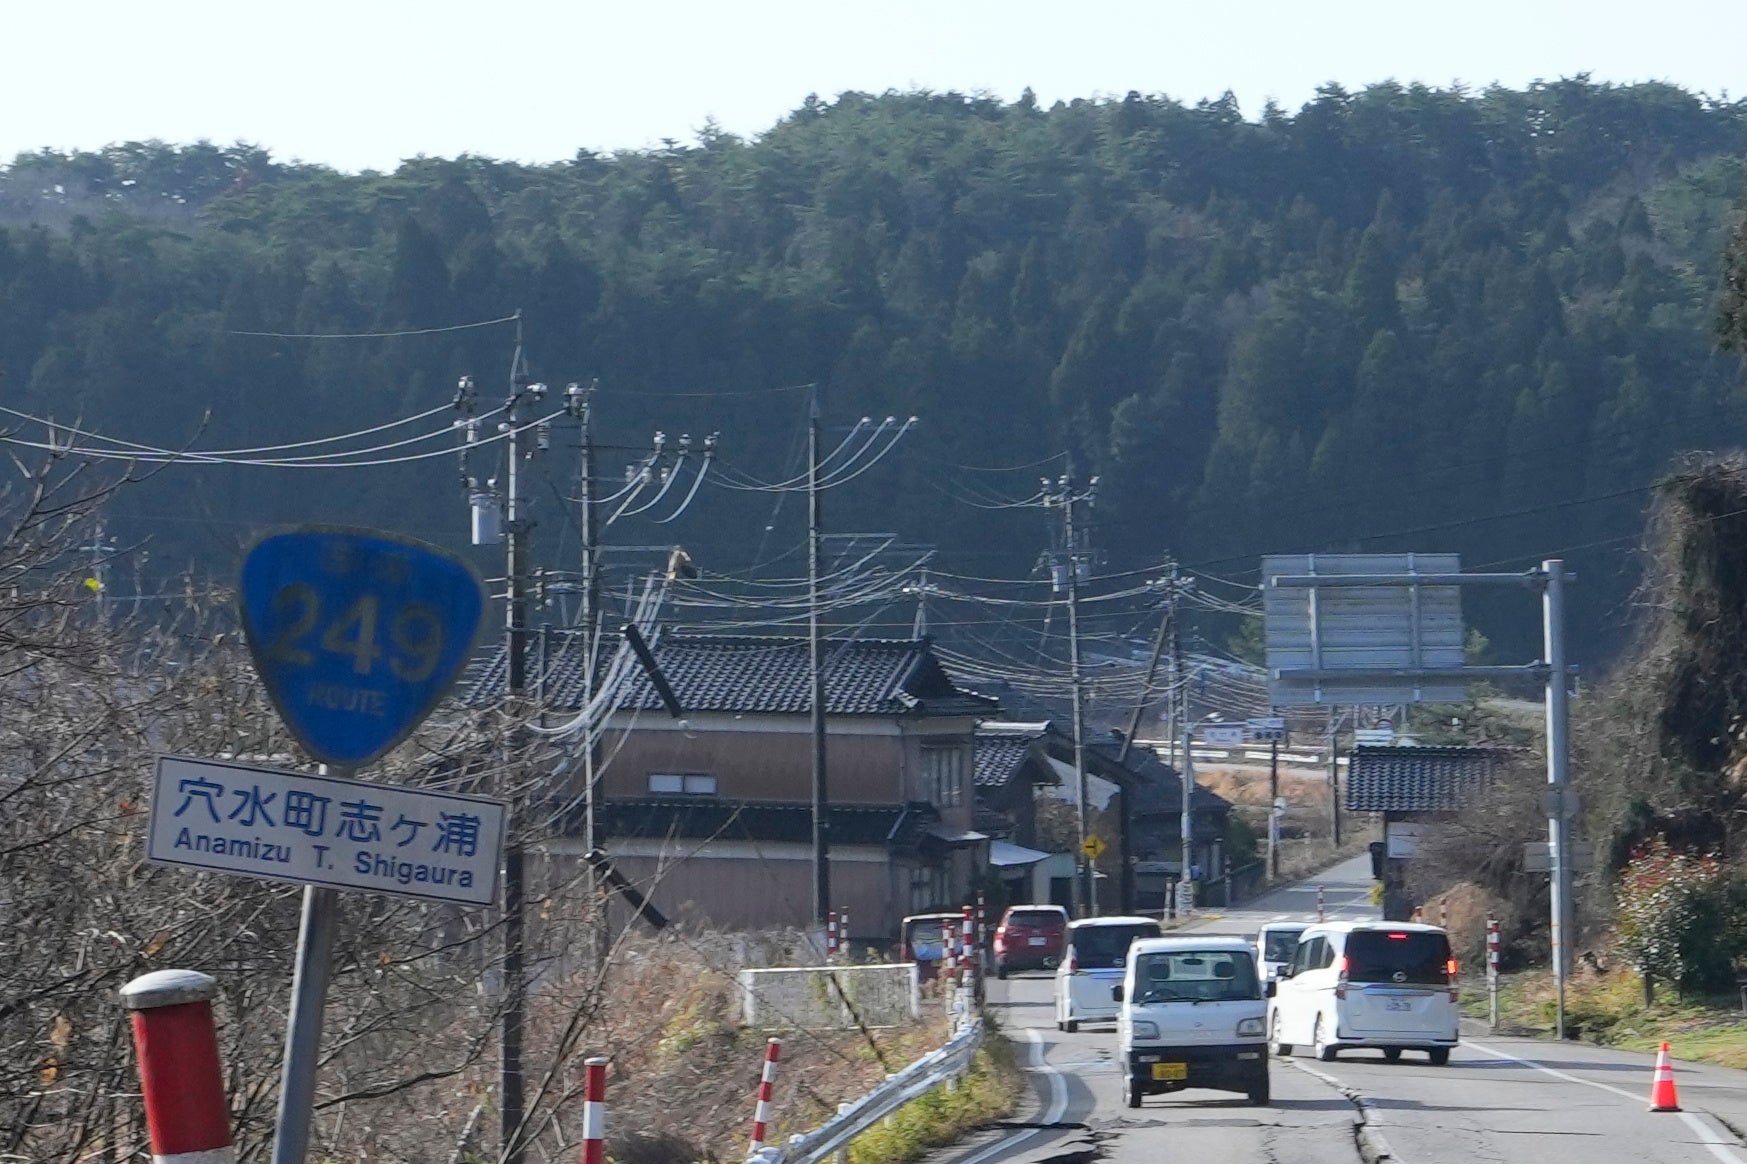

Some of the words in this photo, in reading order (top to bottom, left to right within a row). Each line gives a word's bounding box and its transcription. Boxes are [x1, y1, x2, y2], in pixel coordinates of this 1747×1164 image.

[260, 583, 443, 682] 249
[306, 685, 386, 716] ROUTE
[174, 827, 291, 863] Anamizu
[312, 845, 333, 870] T.
[354, 851, 474, 888] Shigaura
